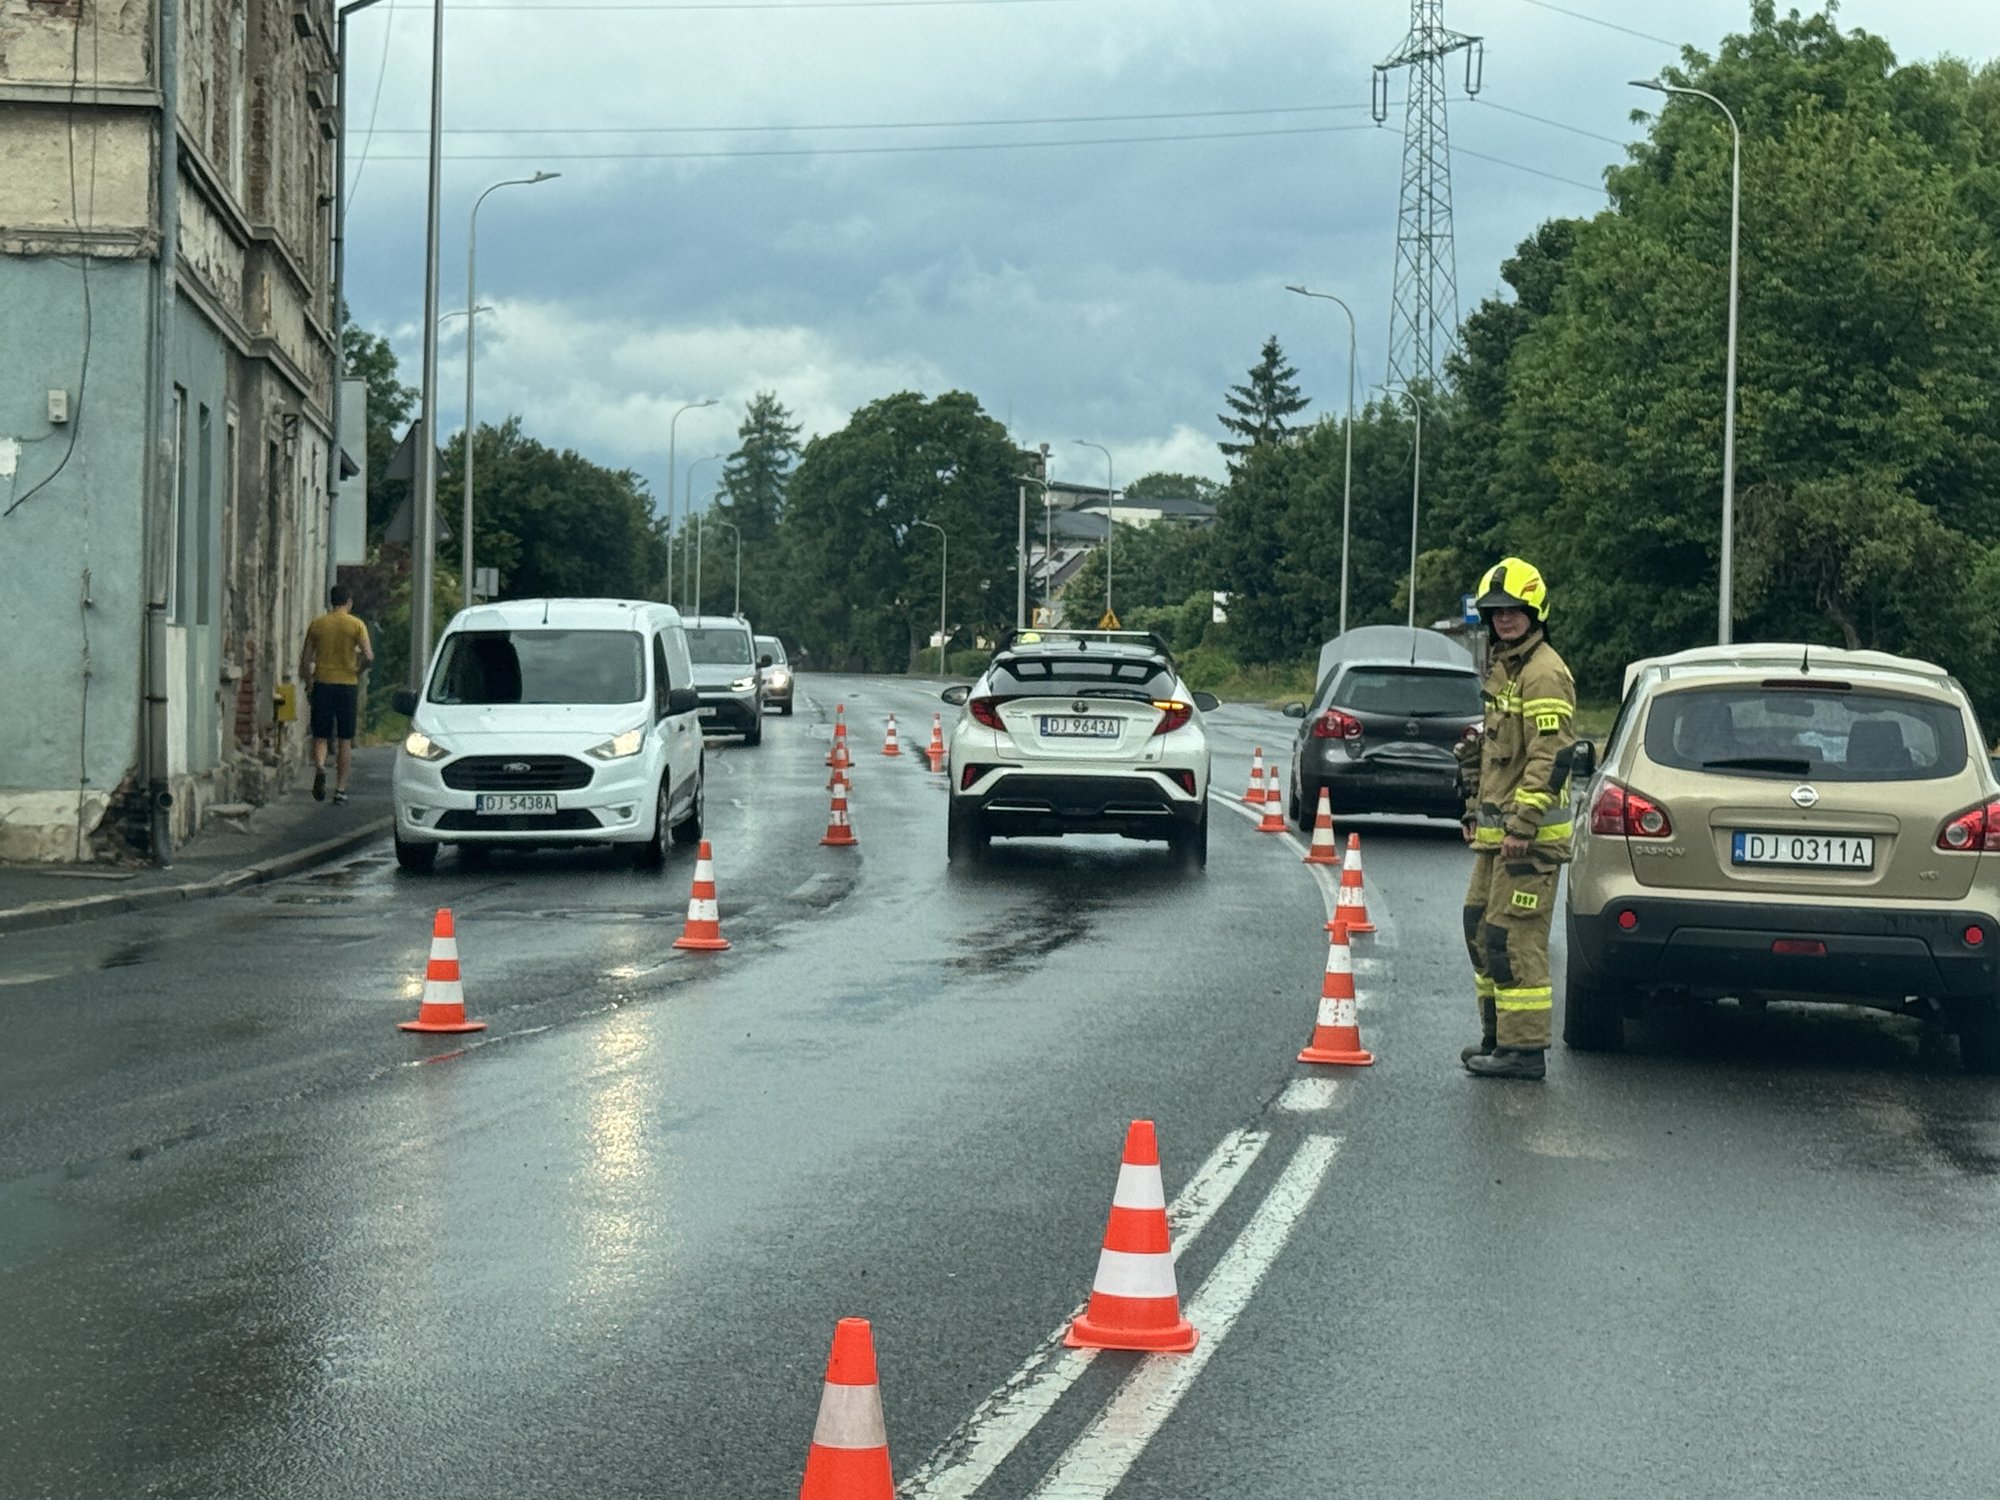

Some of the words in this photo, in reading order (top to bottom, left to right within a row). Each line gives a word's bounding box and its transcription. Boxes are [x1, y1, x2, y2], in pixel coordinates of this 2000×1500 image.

[1050, 718, 1068, 733] DJ
[1072, 719, 1115, 734] 9643A
[486, 796, 504, 810] DJ
[509, 796, 553, 811] 5438A
[1750, 836, 1779, 860] DJ
[1790, 838, 1866, 864] 0311A
[1515, 894, 1535, 906] OSP
